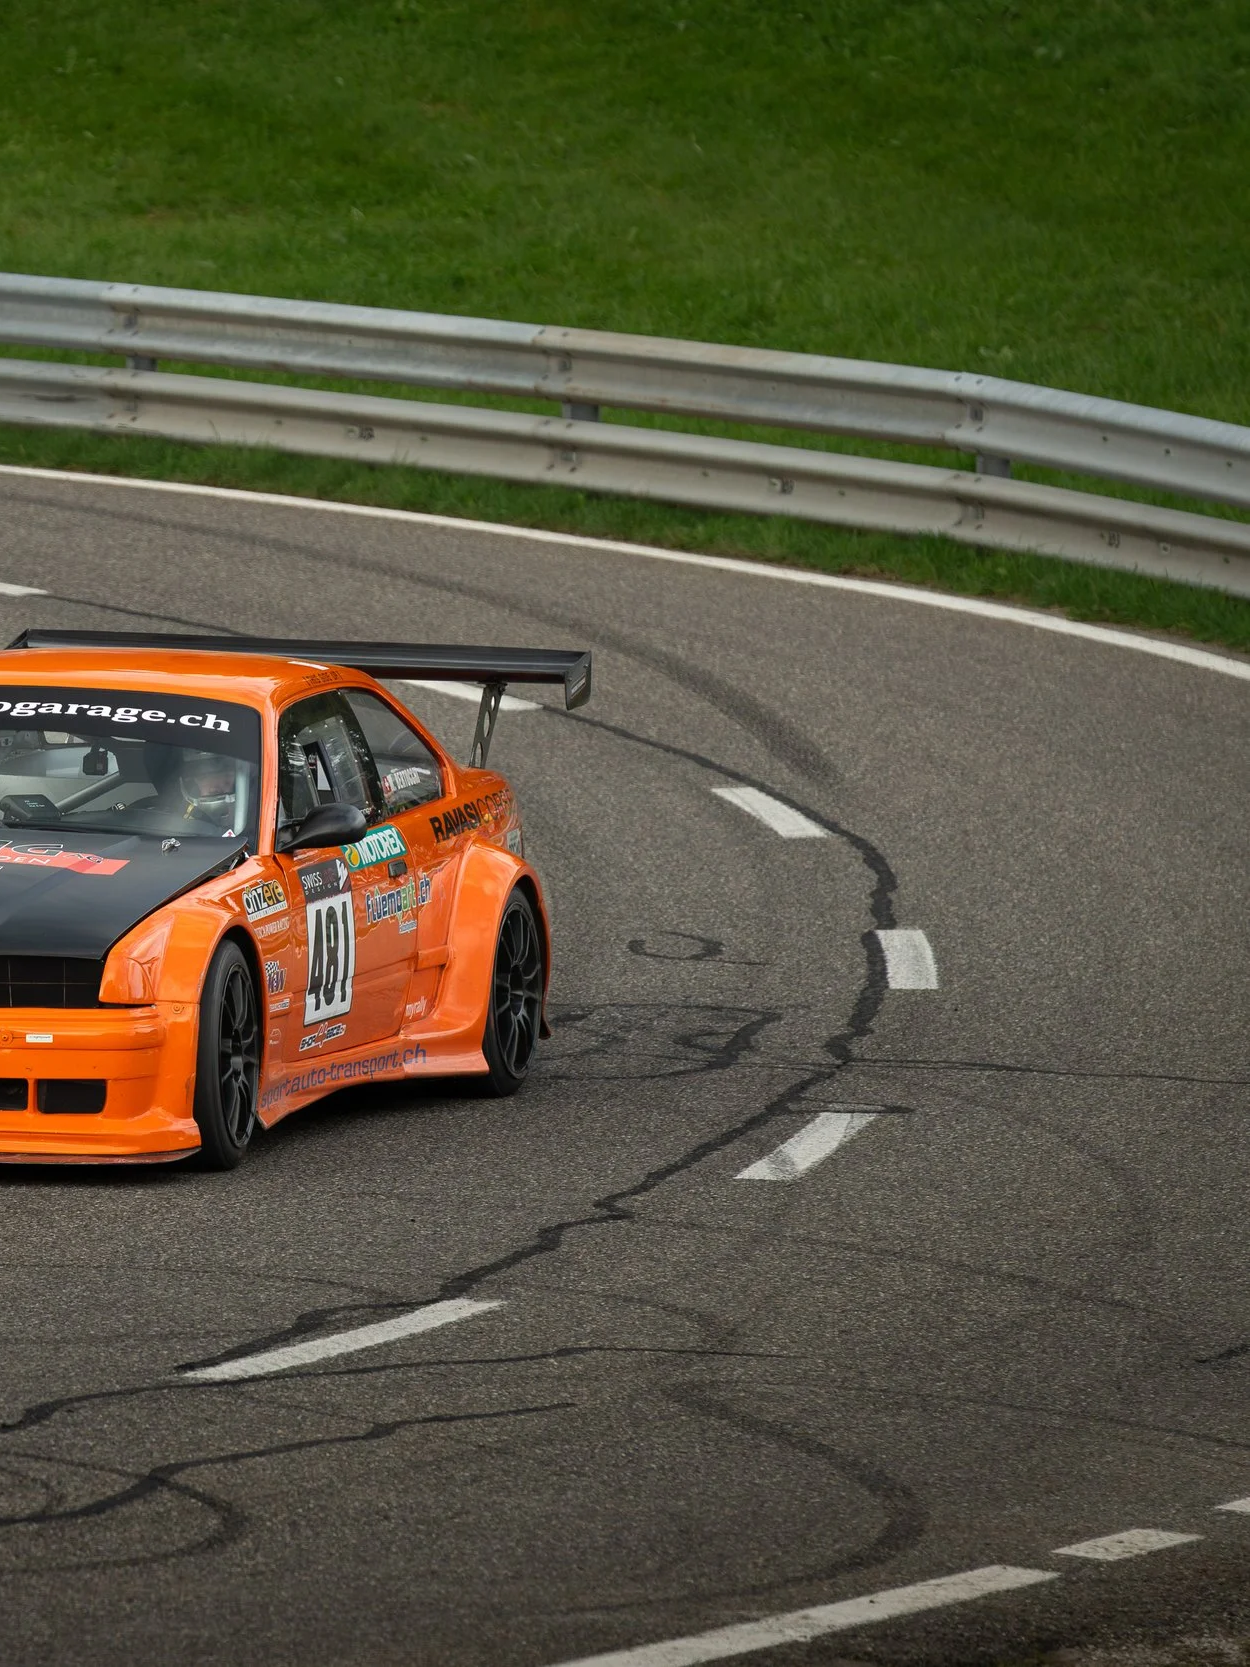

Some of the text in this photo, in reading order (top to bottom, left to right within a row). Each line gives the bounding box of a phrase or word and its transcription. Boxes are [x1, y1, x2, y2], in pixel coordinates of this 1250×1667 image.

[63, 851, 104, 864] AG
[355, 827, 407, 865] MOTOREX
[301, 871, 323, 890] SWISS
[308, 901, 350, 1012] 481
[260, 1042, 427, 1111] sportauto-transport.ch
